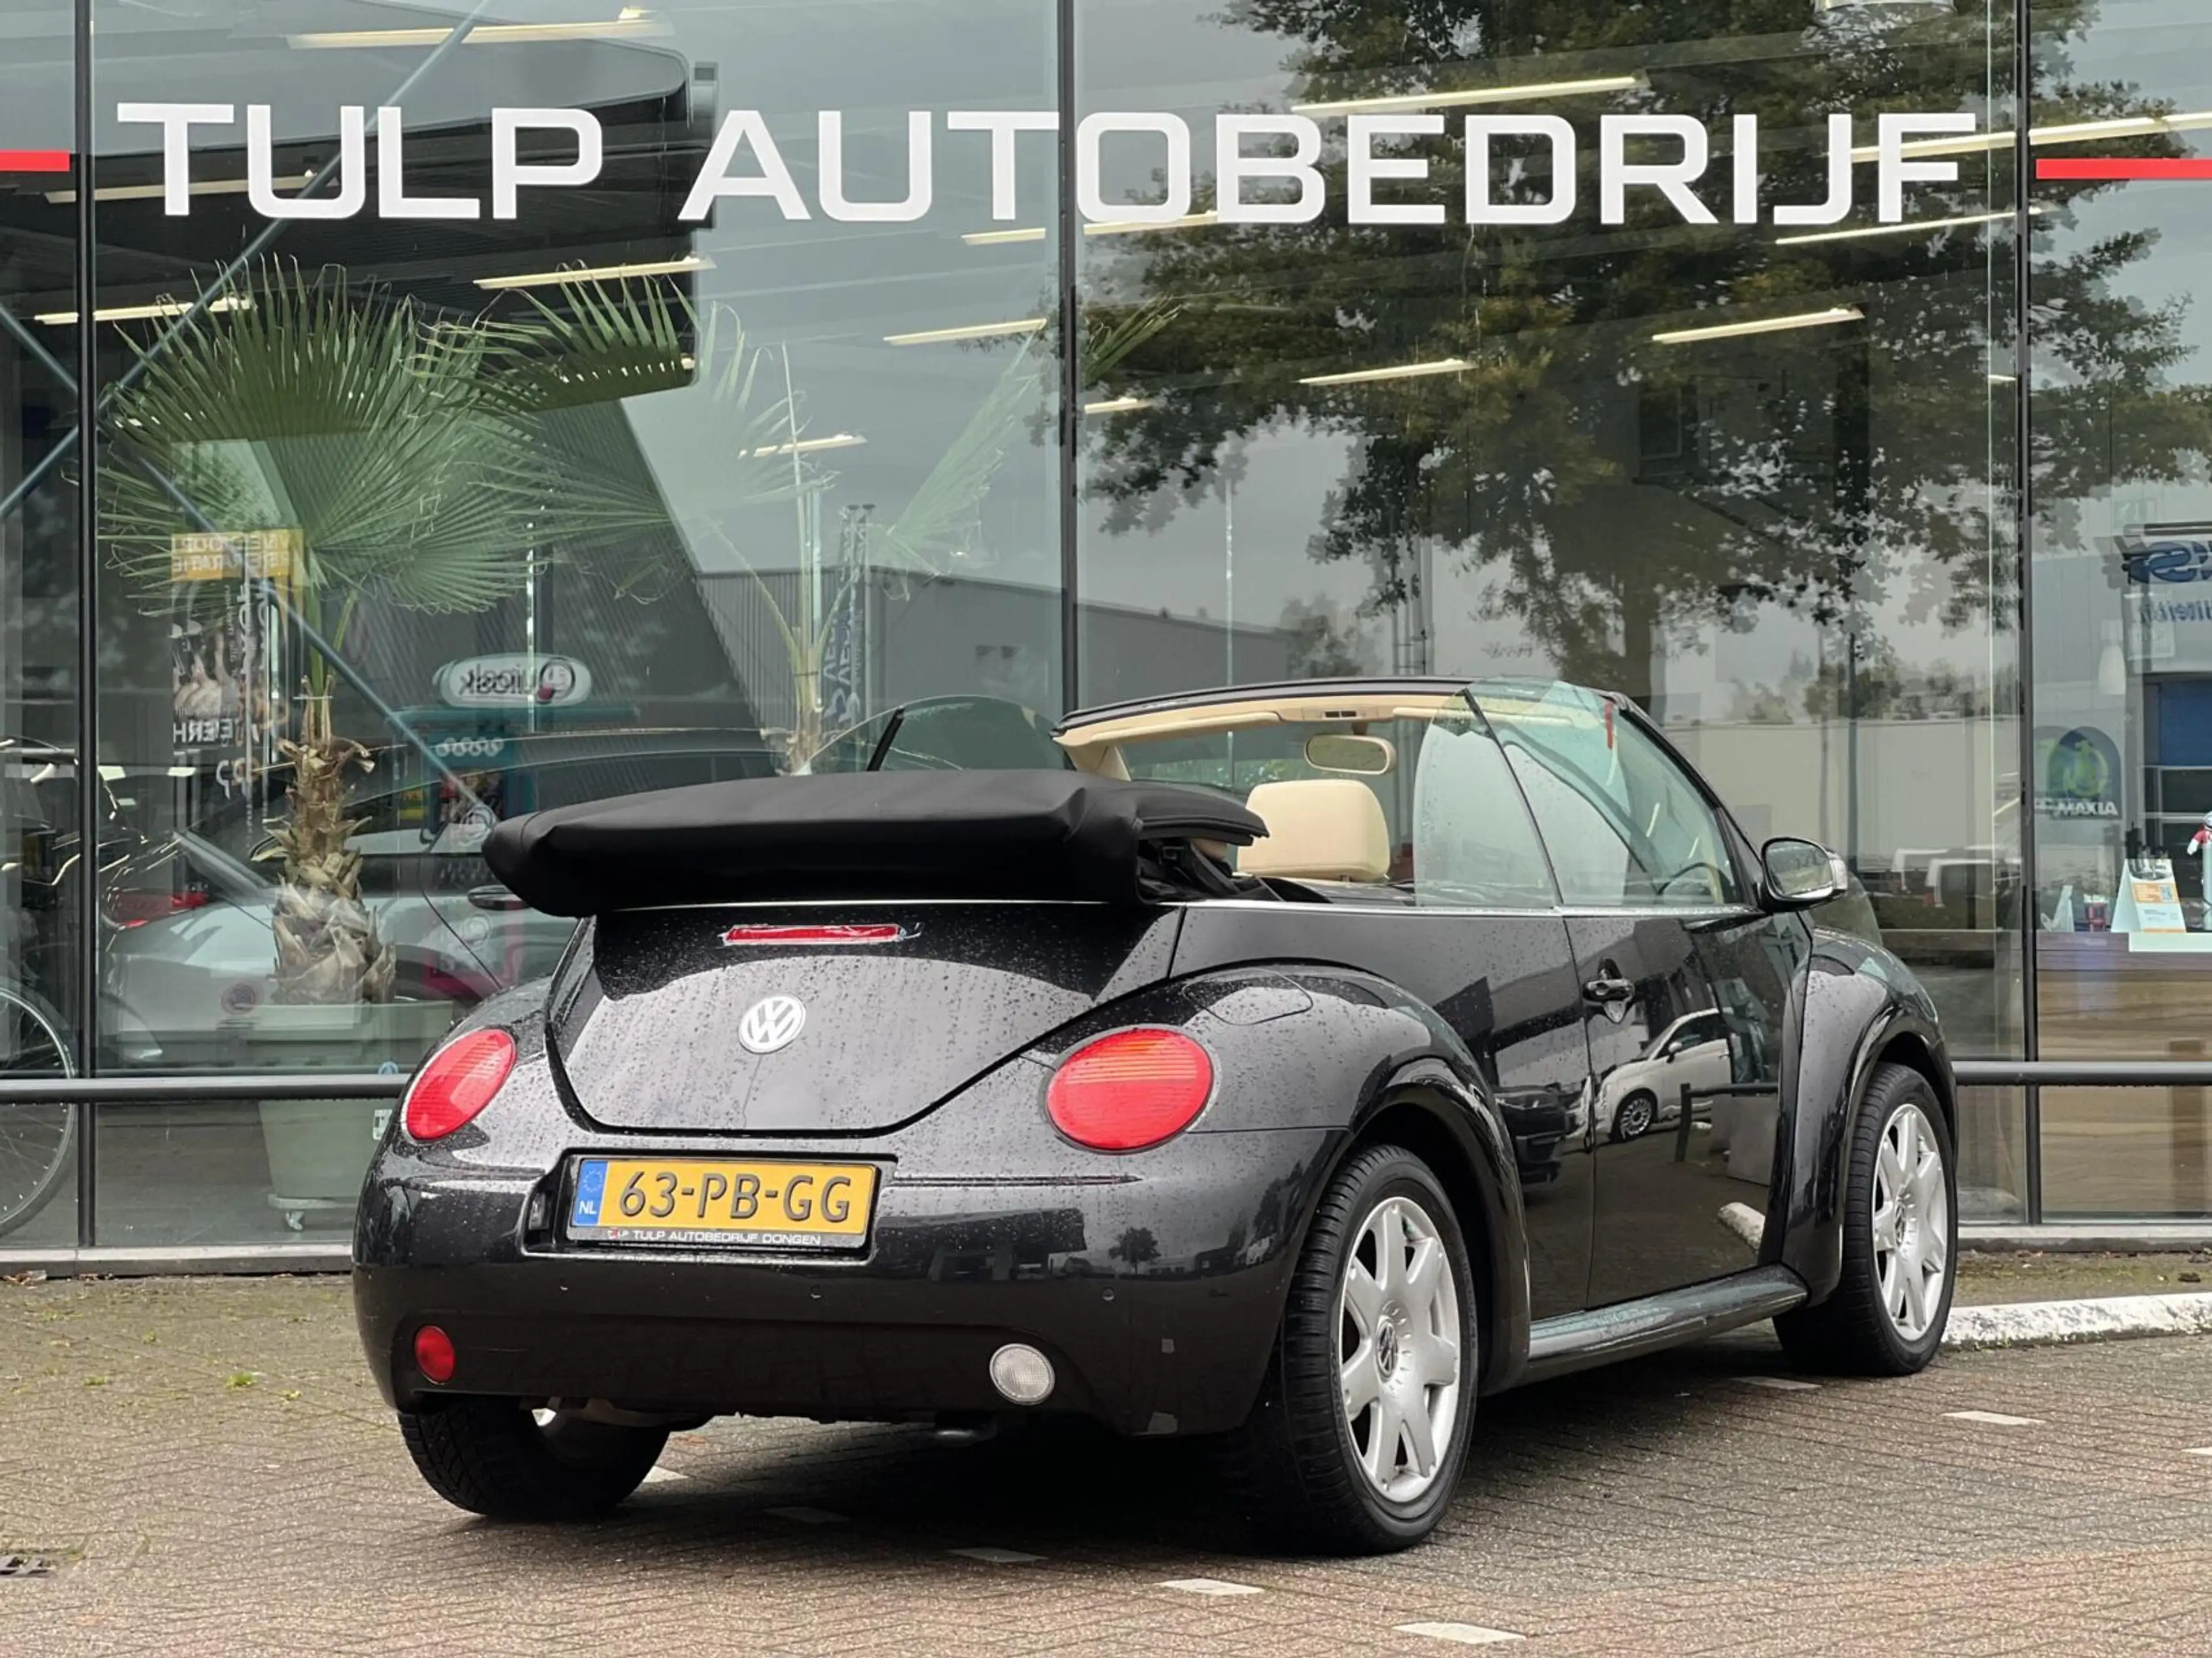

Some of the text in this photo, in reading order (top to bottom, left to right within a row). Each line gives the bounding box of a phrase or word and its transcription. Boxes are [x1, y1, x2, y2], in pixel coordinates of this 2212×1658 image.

[117, 103, 1976, 225] TULP AUTOBEDRIJF
[578, 1200, 597, 1215] NL
[619, 1171, 851, 1223] 63-PB-GG
[632, 1230, 666, 1240] TULP
[668, 1231, 758, 1243] AUTOBEDRIJF
[762, 1234, 821, 1245] DONGEN
